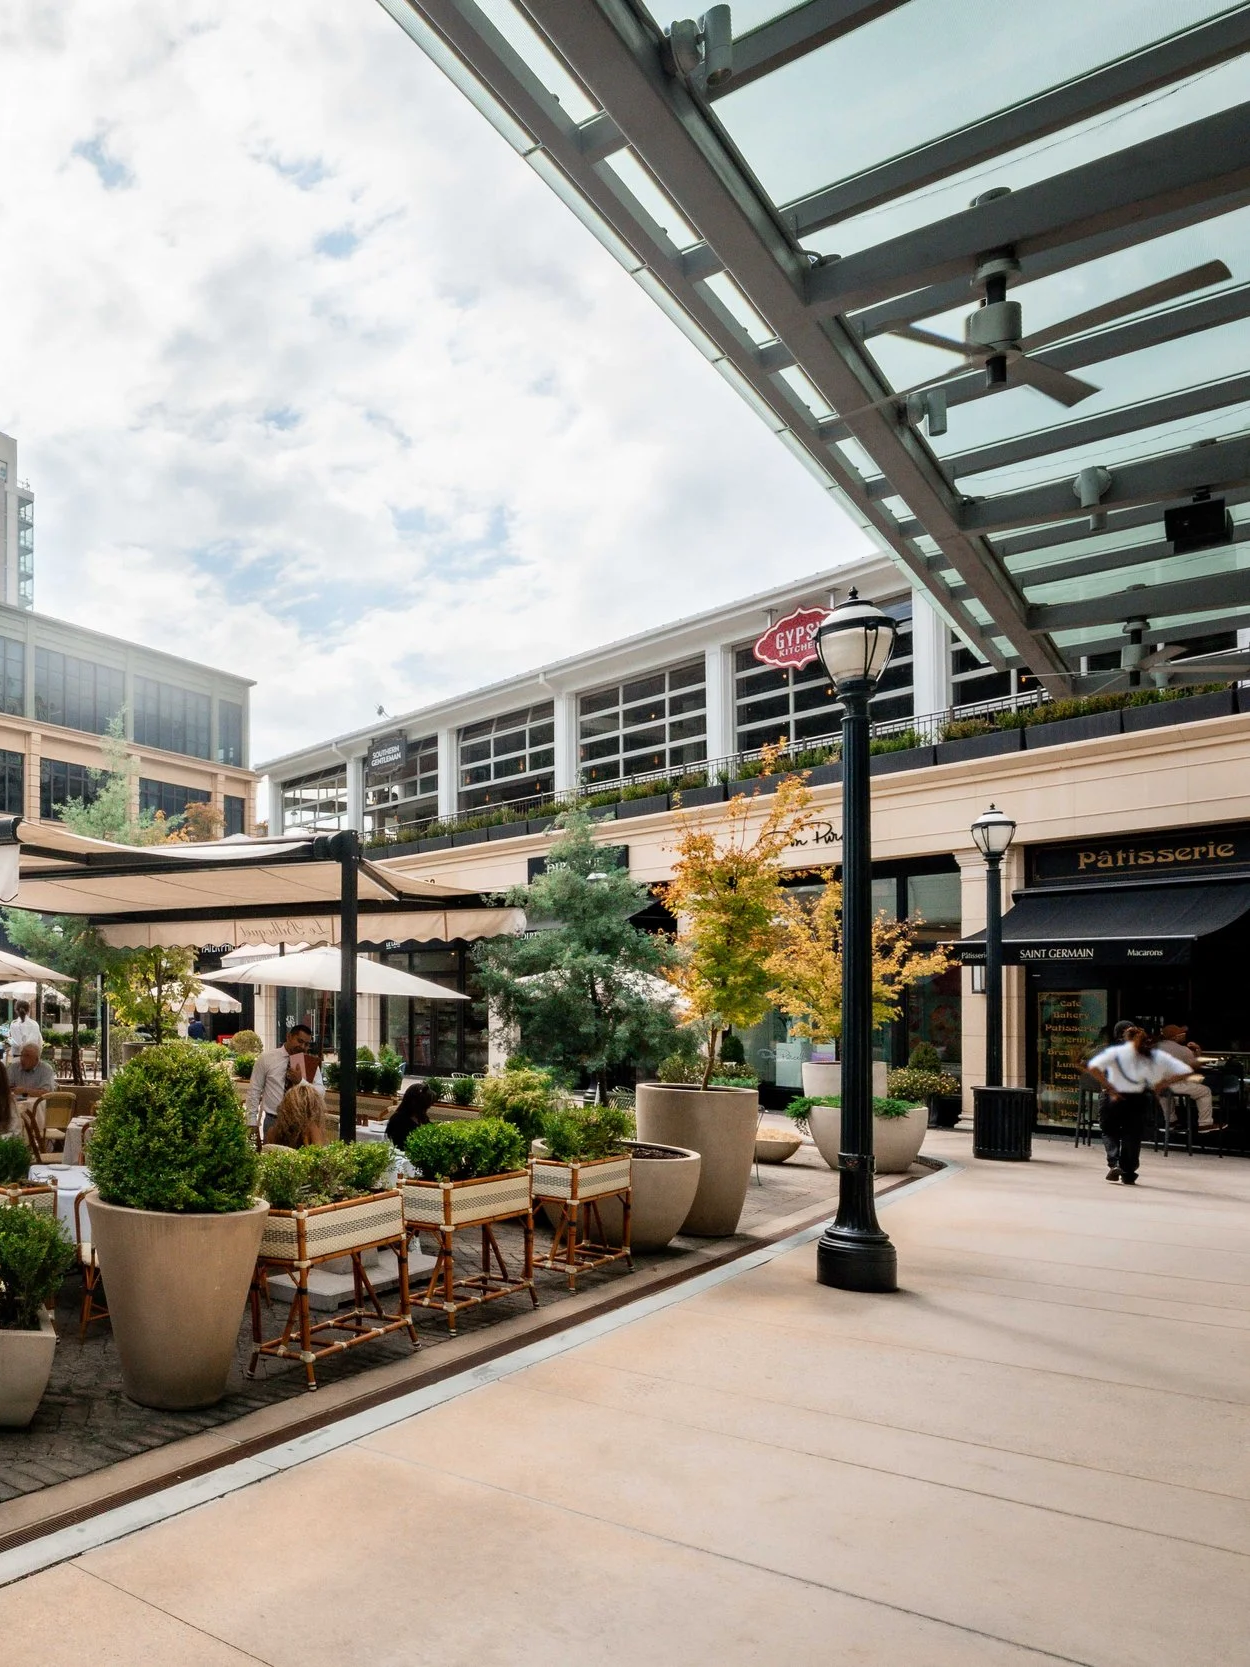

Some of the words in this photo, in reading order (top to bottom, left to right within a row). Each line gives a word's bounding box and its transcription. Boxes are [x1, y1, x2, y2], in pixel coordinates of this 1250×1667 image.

[778, 641, 815, 657] KITCHE
[371, 751, 402, 767] GENTLEMAN
[372, 744, 400, 759] SOUTHERN
[1077, 841, 1235, 870] Pâtisserie
[1019, 949, 1048, 959] SAINT
[1048, 948, 1094, 958] GERMAIN
[1127, 949, 1163, 957] Macarons
